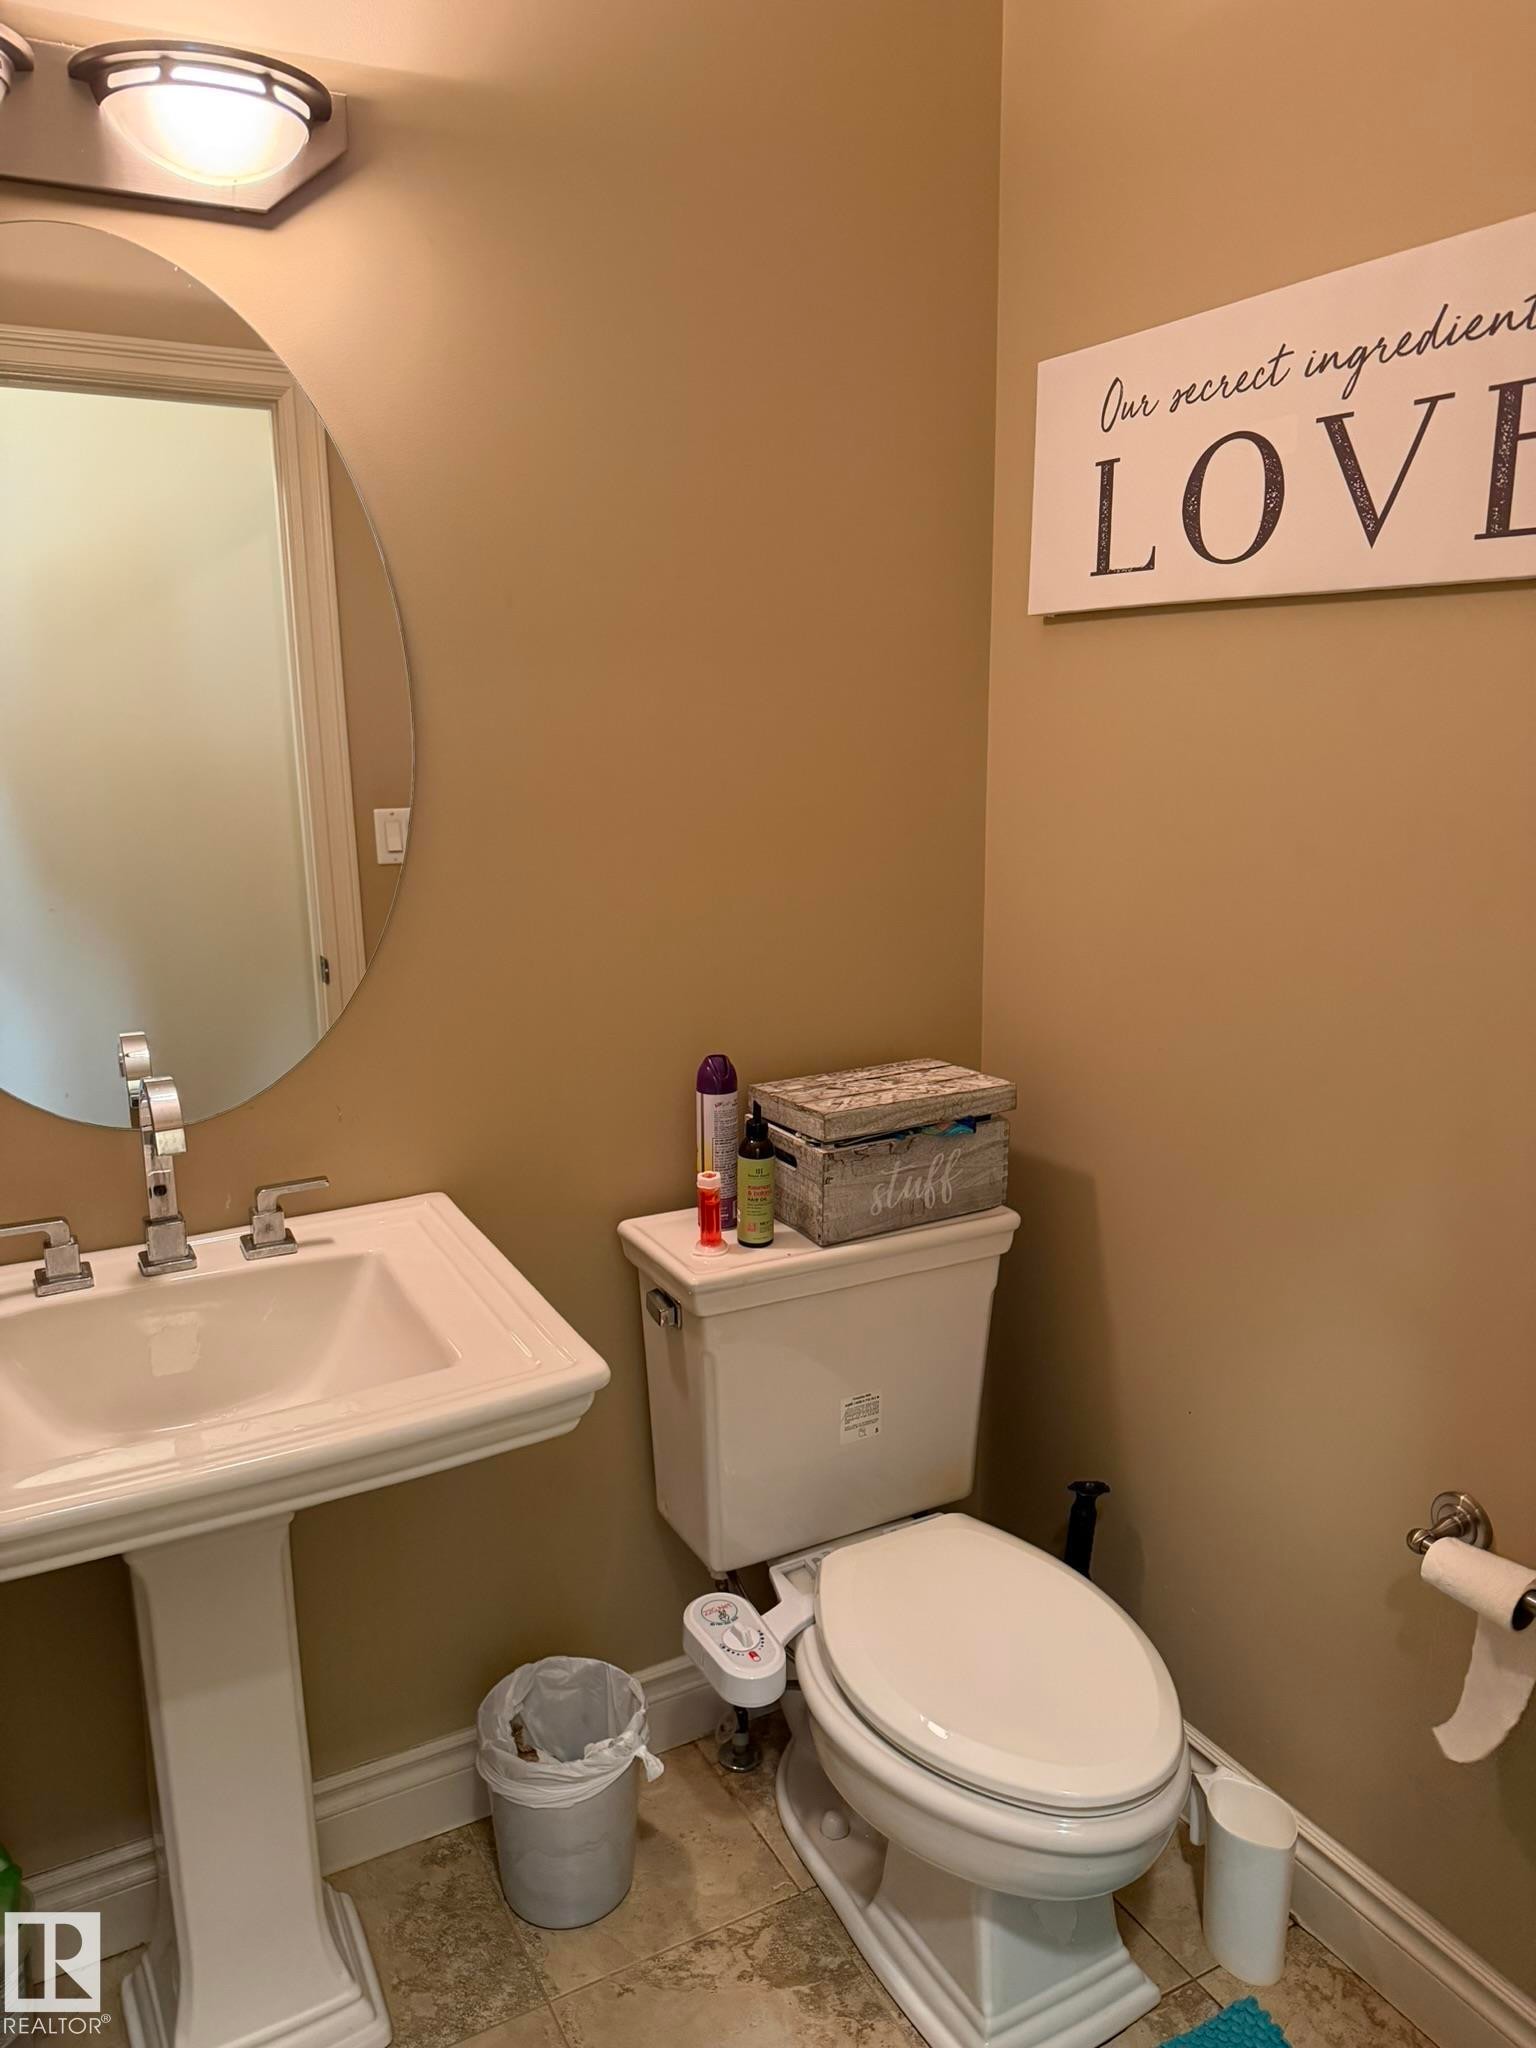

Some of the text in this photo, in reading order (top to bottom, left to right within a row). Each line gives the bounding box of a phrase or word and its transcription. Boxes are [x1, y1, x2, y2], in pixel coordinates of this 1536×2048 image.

[1101, 376, 1159, 433] Our
[1169, 343, 1295, 413] secrect
[870, 1148, 964, 1216] stuff
